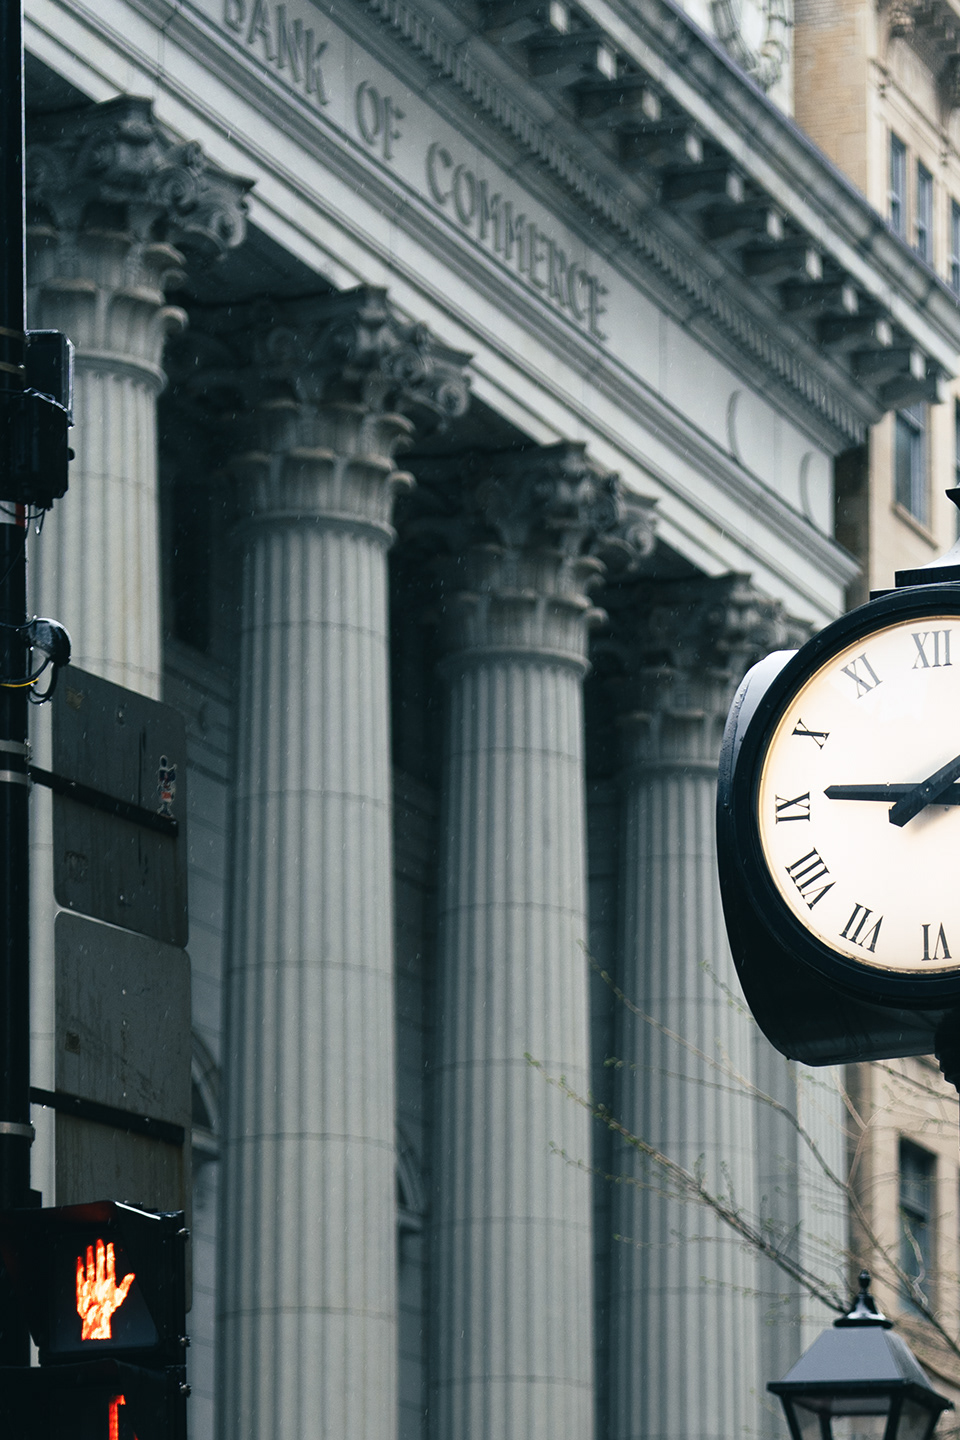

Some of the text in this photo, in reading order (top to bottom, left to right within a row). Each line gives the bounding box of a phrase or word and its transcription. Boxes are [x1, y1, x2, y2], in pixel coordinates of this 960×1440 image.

[355, 79, 406, 160] OF
[424, 142, 609, 341] COMMERCE
[911, 629, 953, 669] XII
[841, 652, 883, 698] XI
[792, 718, 830, 749] X
[775, 791, 811, 824] IX
[785, 847, 836, 910] VIII
[839, 902, 883, 953] VII
[921, 922, 952, 961] VI
